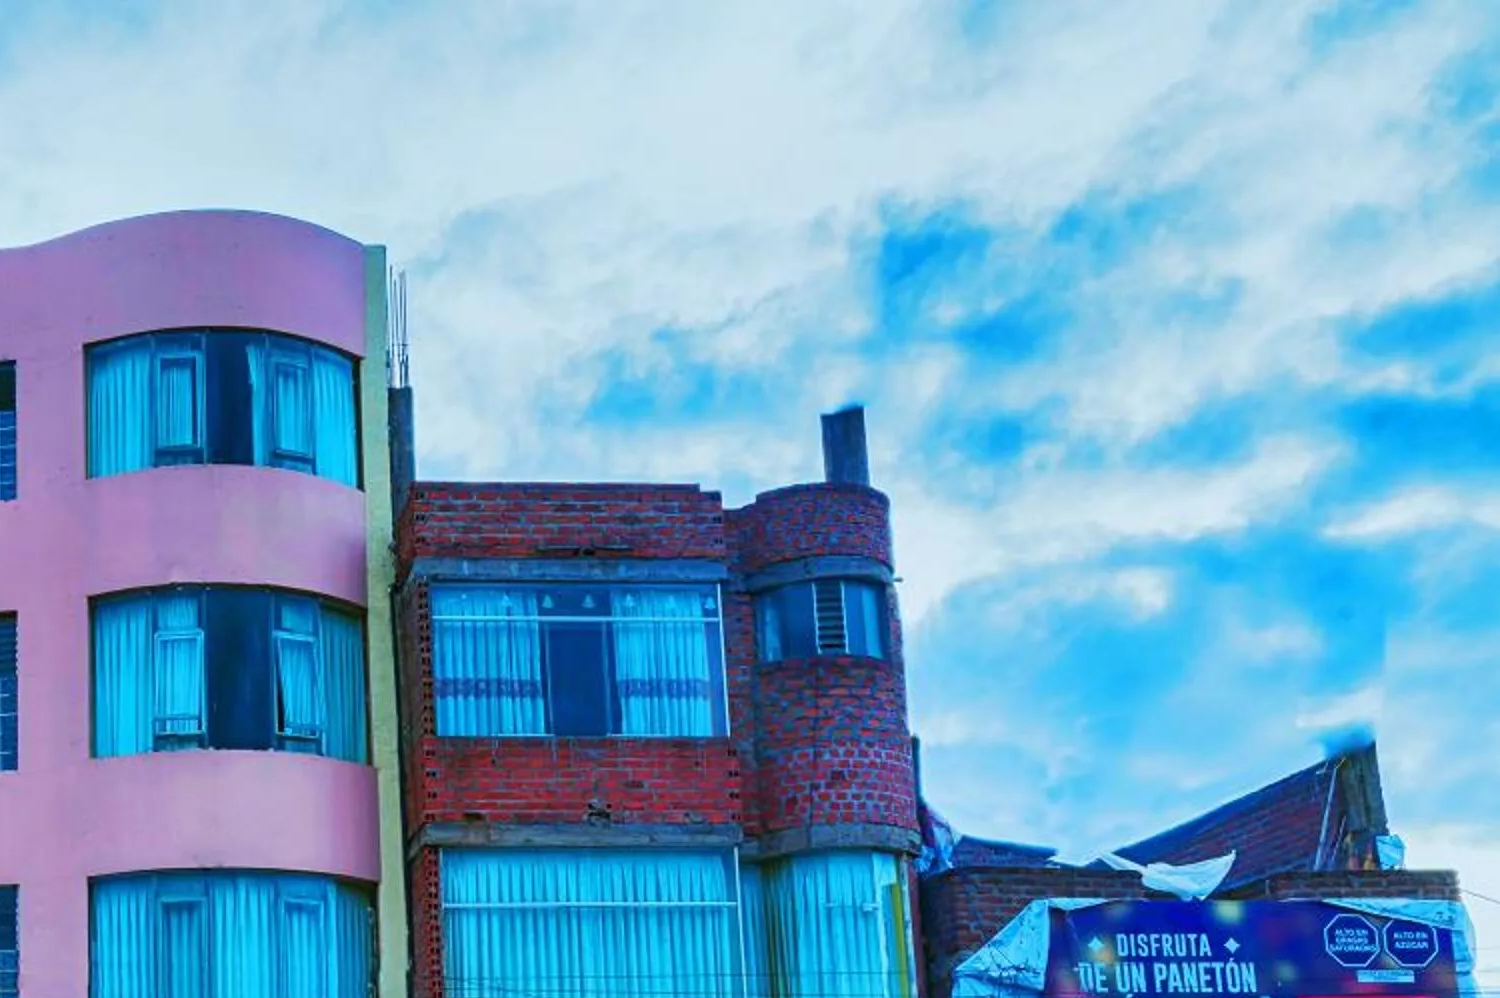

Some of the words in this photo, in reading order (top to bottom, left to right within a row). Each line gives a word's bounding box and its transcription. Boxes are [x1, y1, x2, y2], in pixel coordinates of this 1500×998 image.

[1116, 933, 1213, 957] DISFRUTA
[1077, 962, 1108, 993] DE
[1115, 962, 1147, 993] UN
[1153, 958, 1257, 993] PANETÓN
